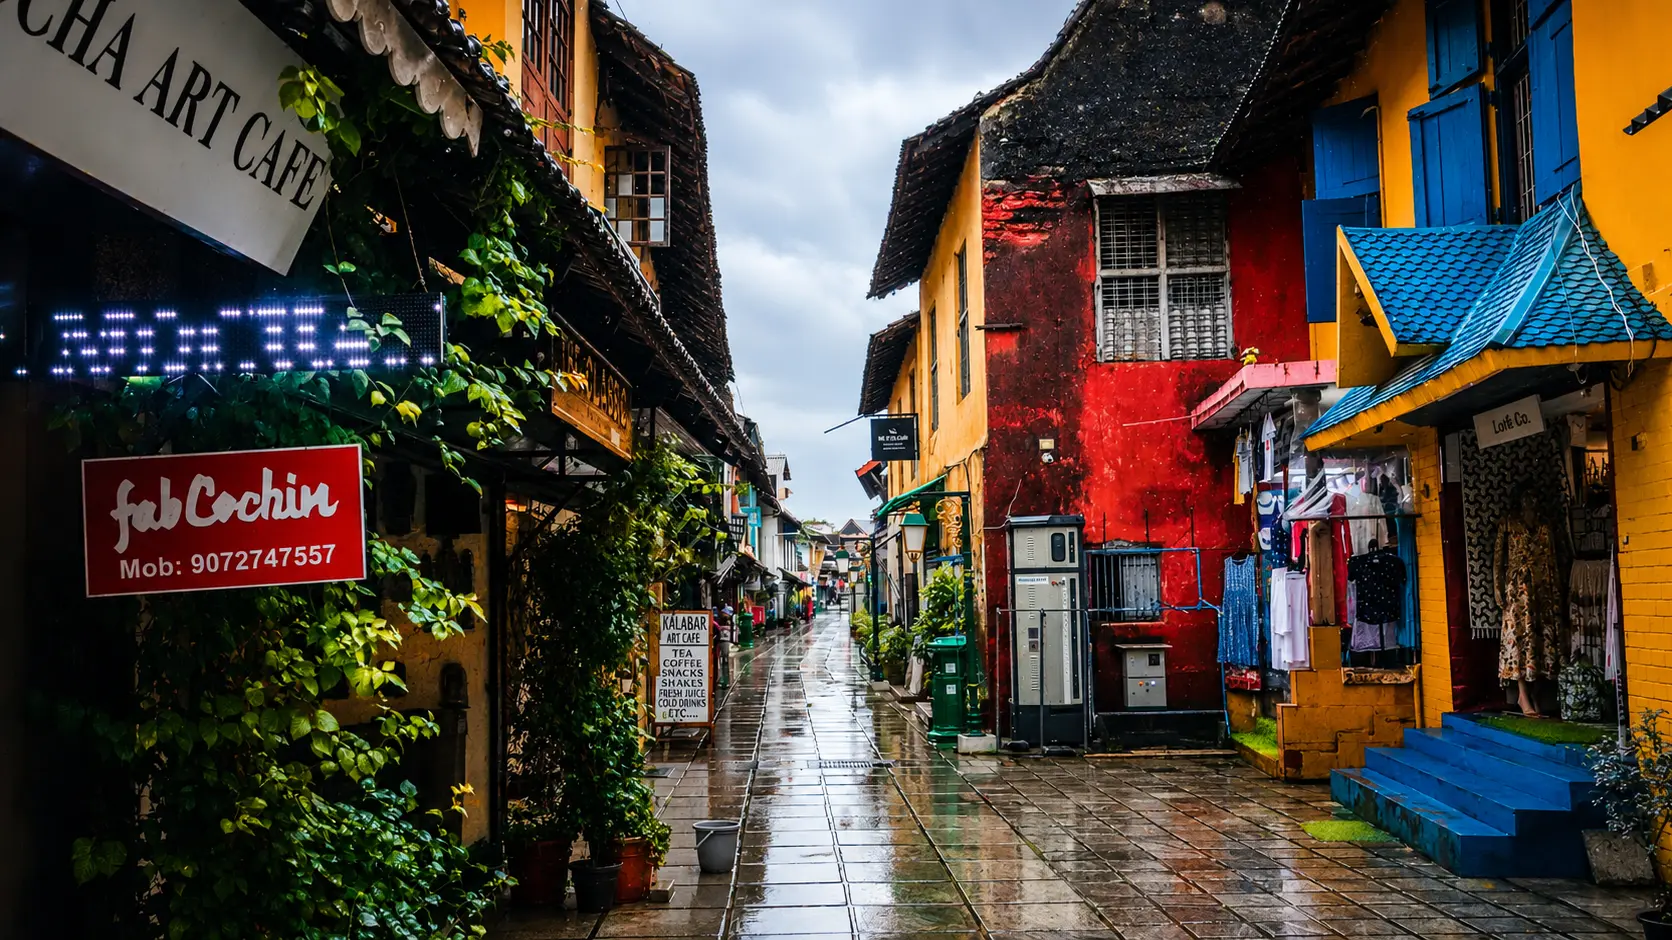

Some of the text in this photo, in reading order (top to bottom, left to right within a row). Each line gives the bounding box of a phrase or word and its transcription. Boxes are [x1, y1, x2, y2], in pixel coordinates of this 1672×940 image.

[0, 0, 327, 211] CHA ART CAFE
[120, 544, 336, 579] Mob: 9072747557
[662, 615, 708, 631] KALABAR
[667, 632, 701, 643] ART CAFE
[672, 649, 693, 658] TEA
[663, 659, 702, 668] COFFEE
[661, 669, 704, 678] SNACKS
[661, 679, 703, 687] SHAKES
[659, 689, 706, 698] FRESH JUICE
[658, 698, 707, 708] COLD DRINKS
